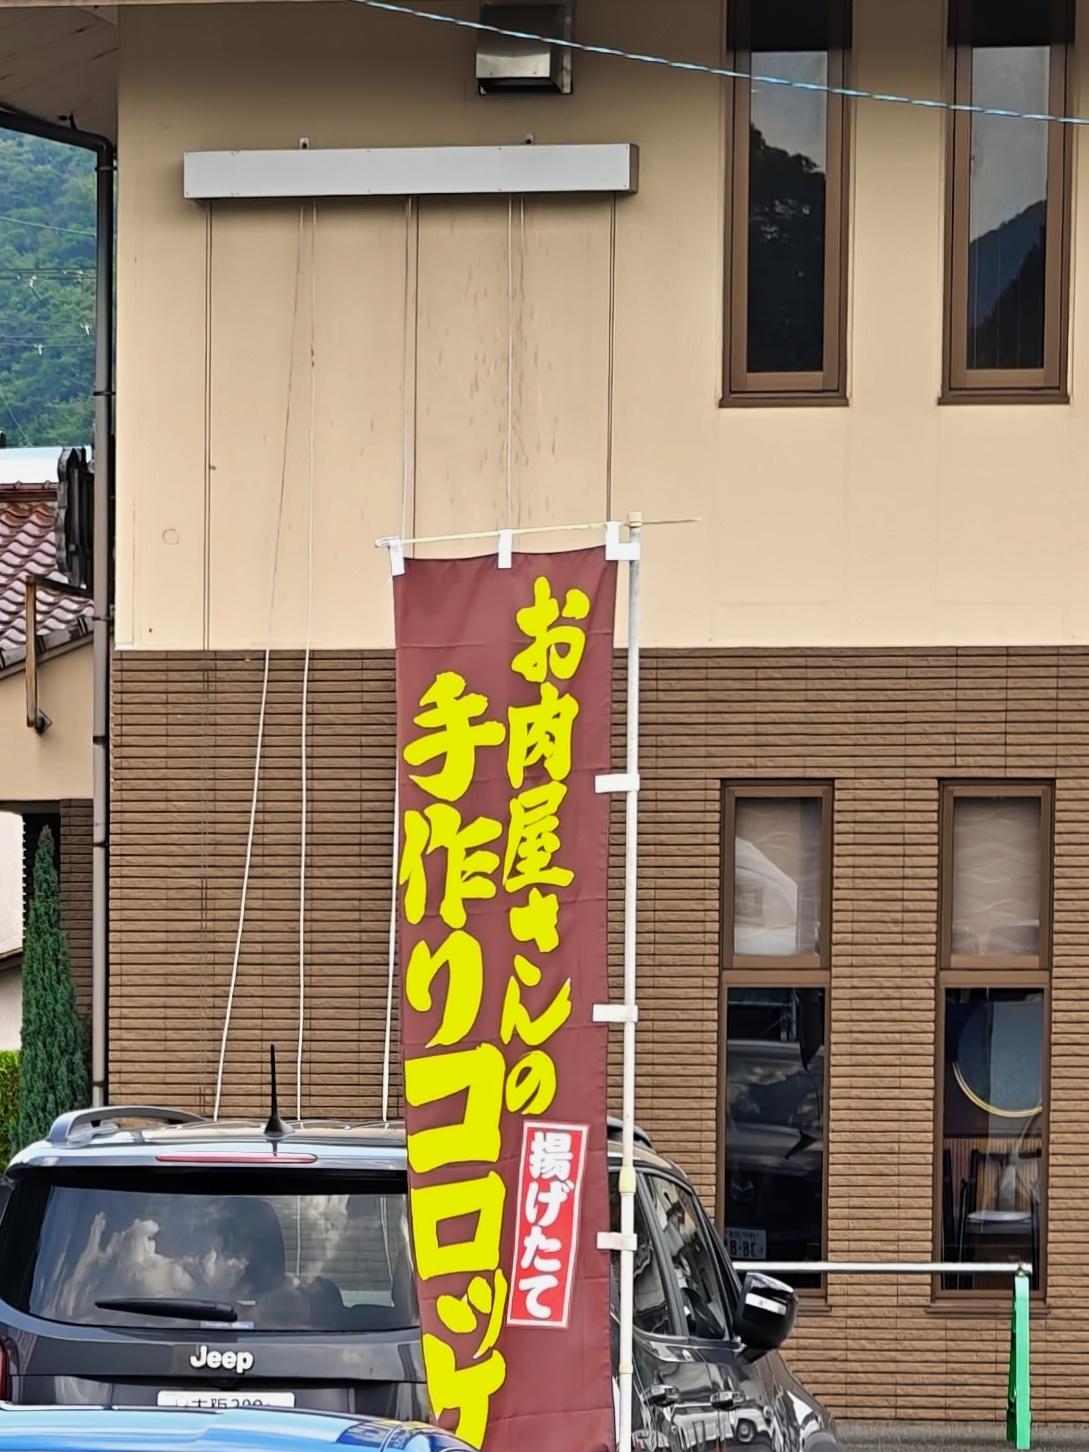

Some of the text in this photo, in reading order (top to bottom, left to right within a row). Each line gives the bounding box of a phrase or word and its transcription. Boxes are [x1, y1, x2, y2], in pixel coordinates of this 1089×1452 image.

[499, 576, 590, 1115] お肉屋さんの
[399, 671, 508, 1450] 手作りコロッケ
[519, 1131, 575, 1319] 揚げたて
[189, 1345, 254, 1374] Jeep
